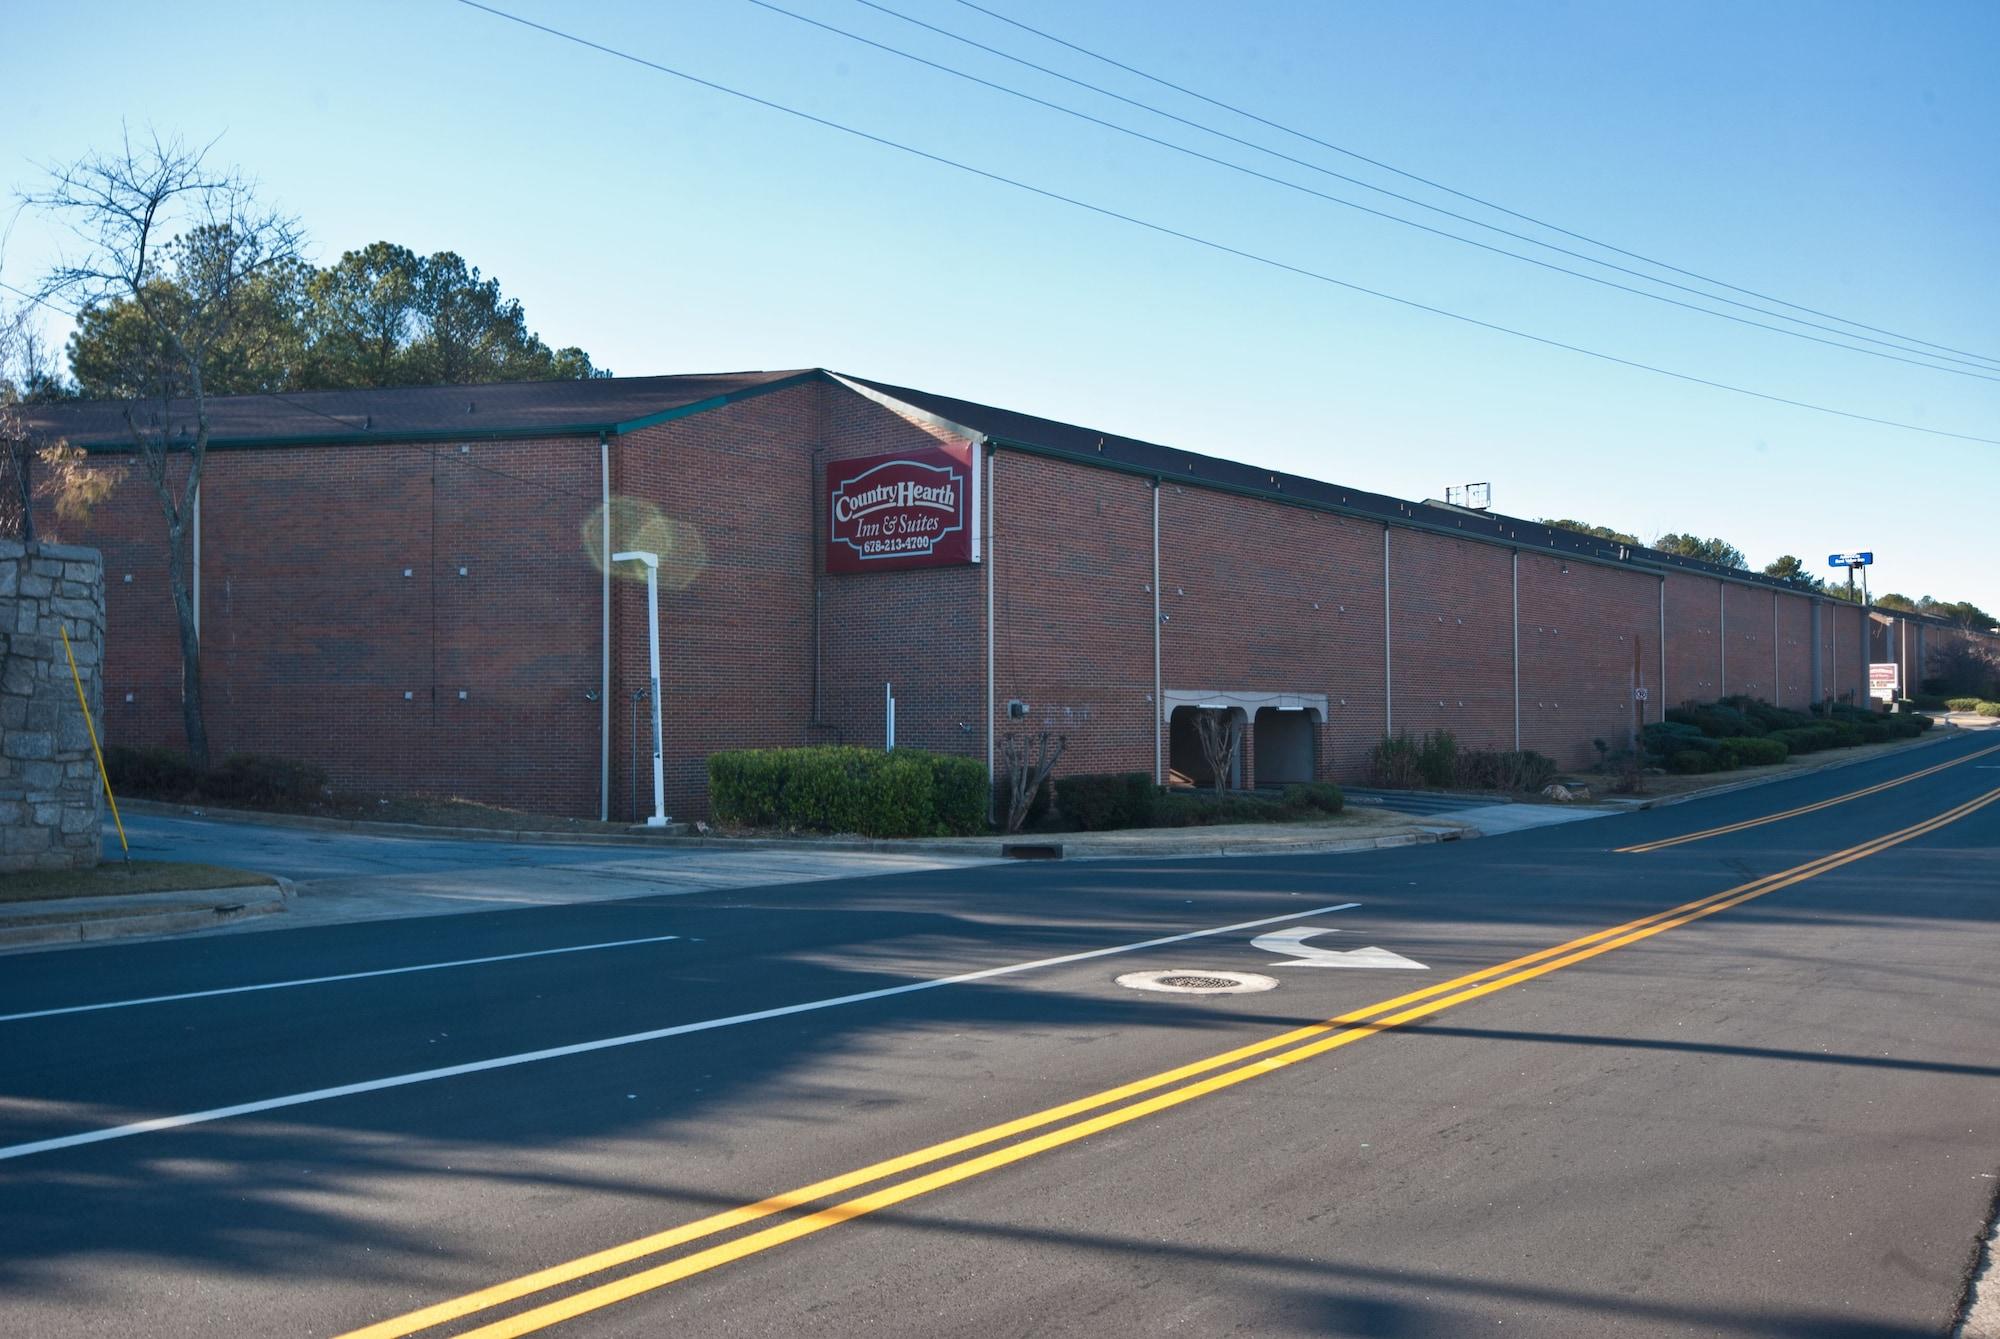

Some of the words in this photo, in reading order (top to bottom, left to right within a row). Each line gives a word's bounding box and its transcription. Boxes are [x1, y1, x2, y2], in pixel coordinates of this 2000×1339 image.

[857, 519, 879, 537] Inn
[883, 516, 897, 535] &
[899, 514, 939, 533] Suites
[864, 536, 929, 553] 678-213-4700
